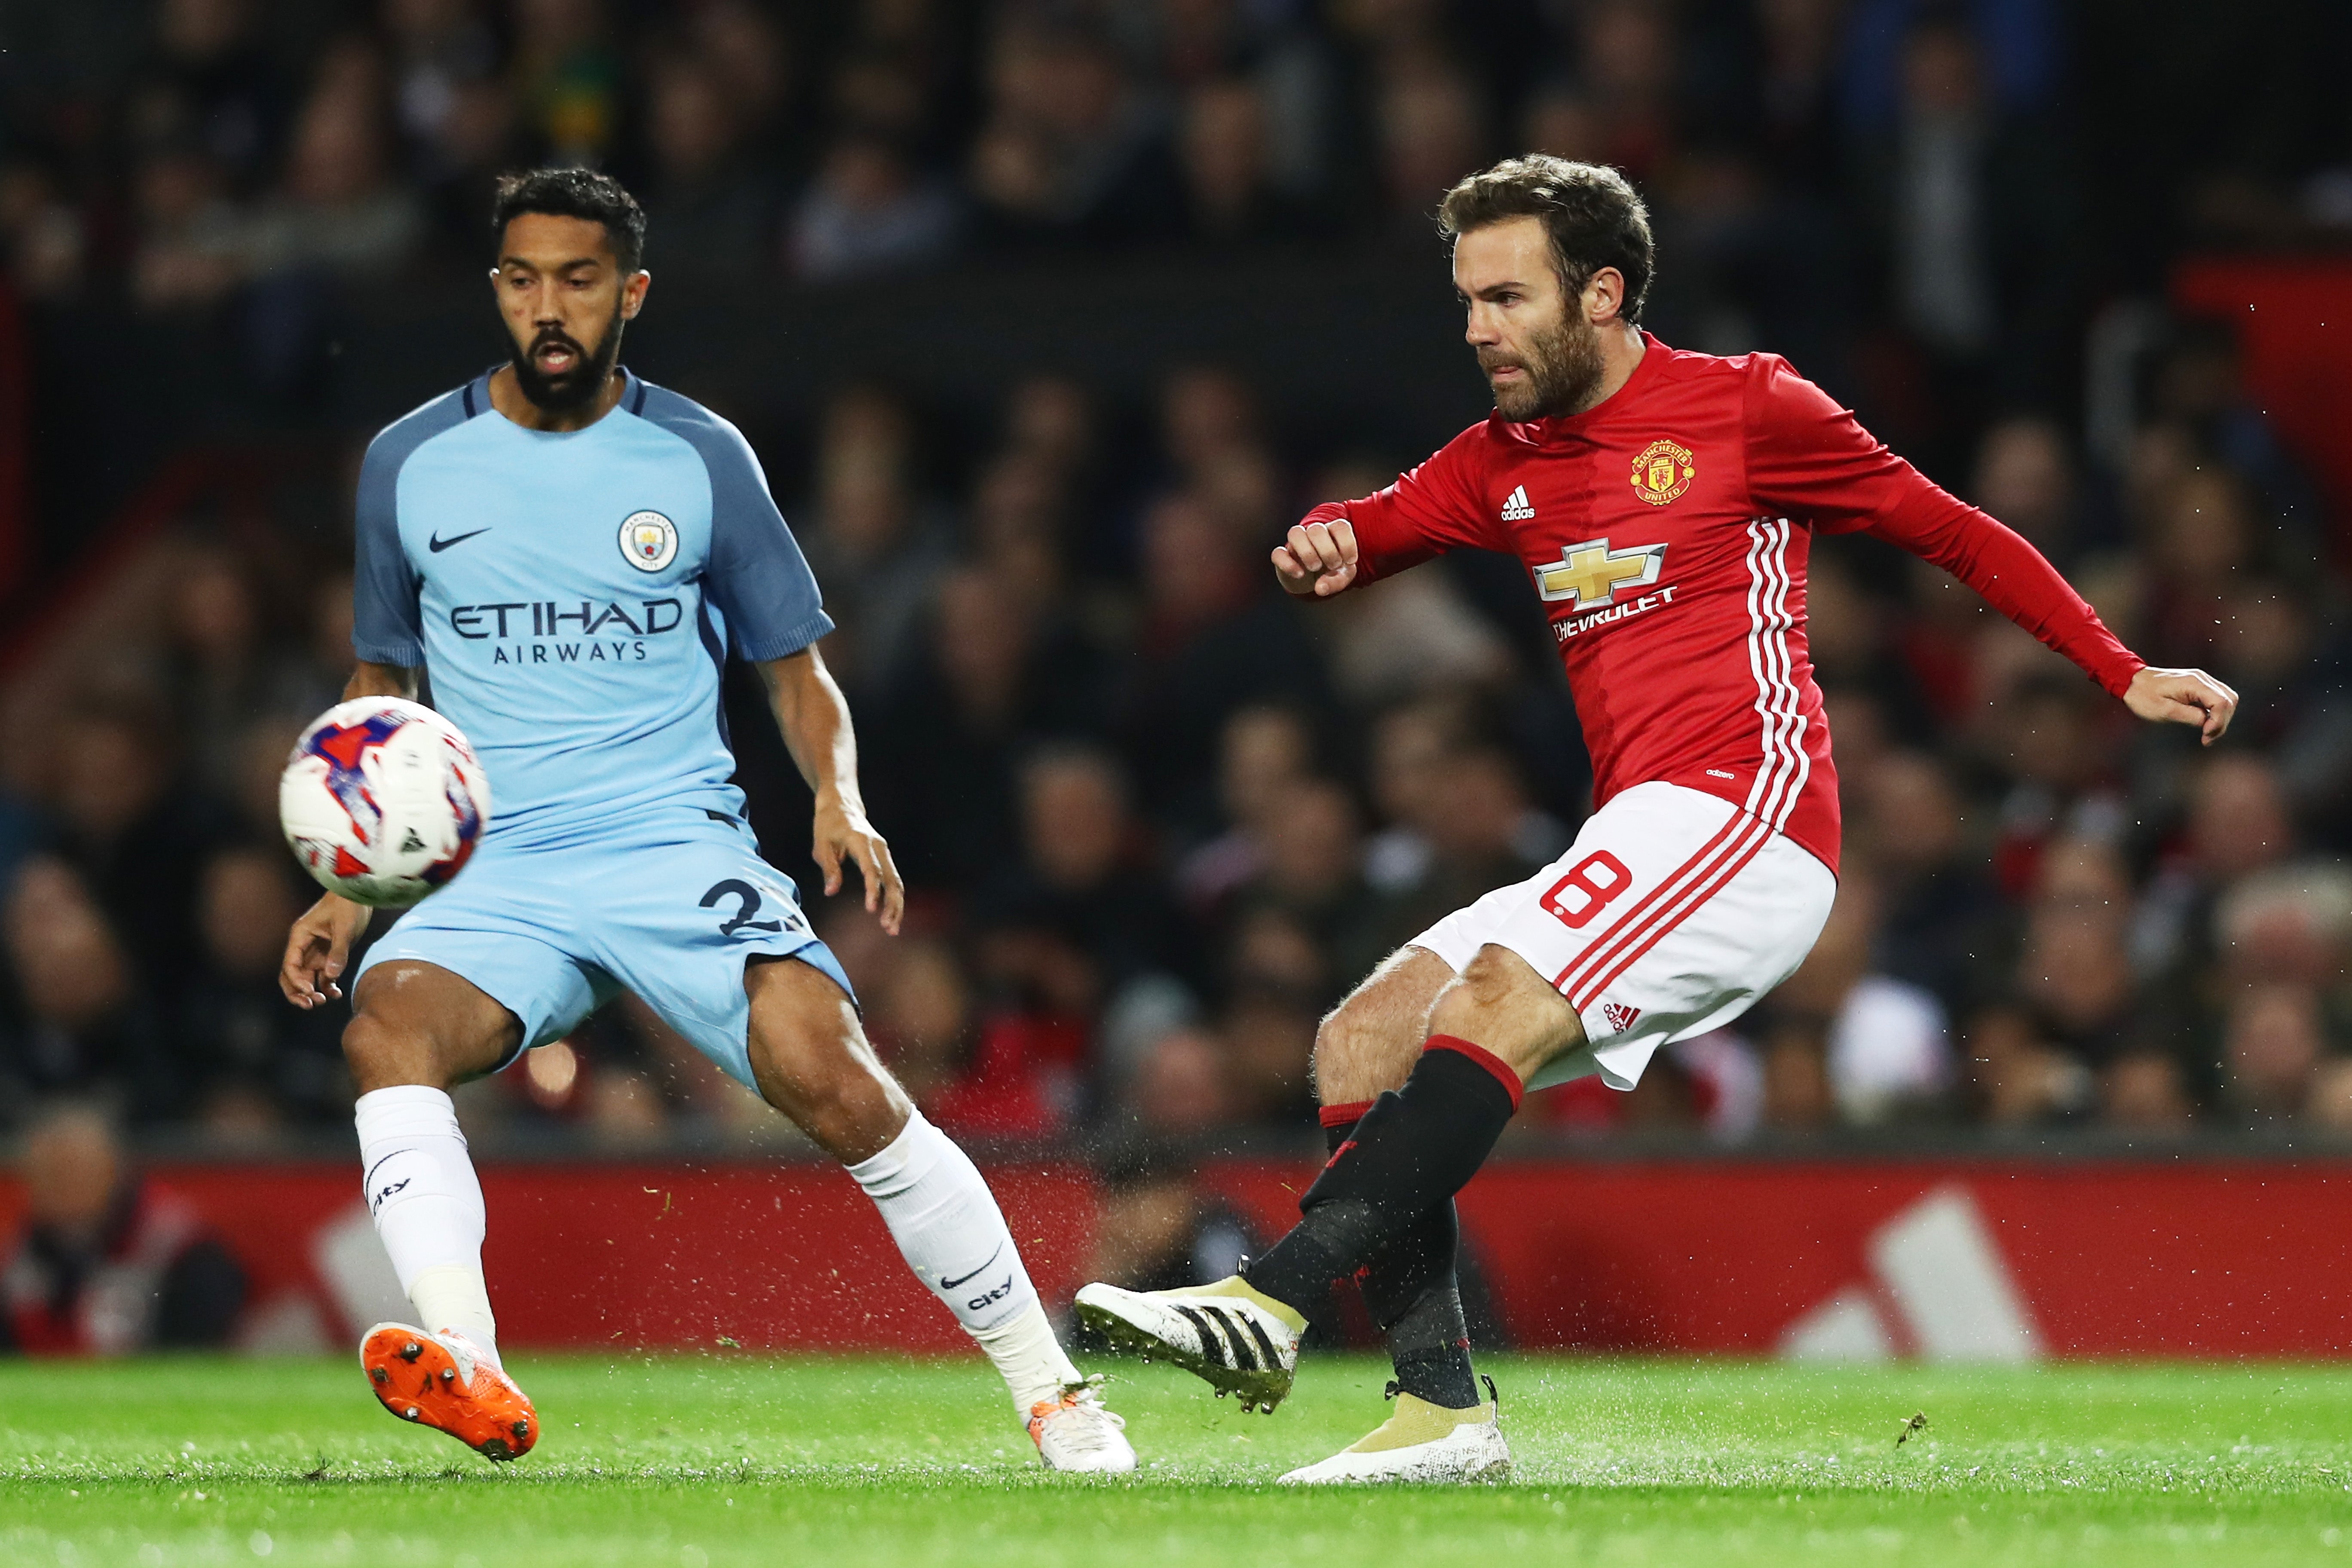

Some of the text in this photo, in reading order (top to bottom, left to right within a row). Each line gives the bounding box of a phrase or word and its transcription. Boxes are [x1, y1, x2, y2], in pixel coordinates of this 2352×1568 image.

[1637, 445, 1687, 469] MANCHESTER
[1645, 488, 1680, 501] UNITED
[1501, 507, 1535, 521] adidas
[451, 598, 683, 639] ETIHAD
[494, 641, 646, 664] AIRWAYS
[1540, 850, 1632, 929] 8
